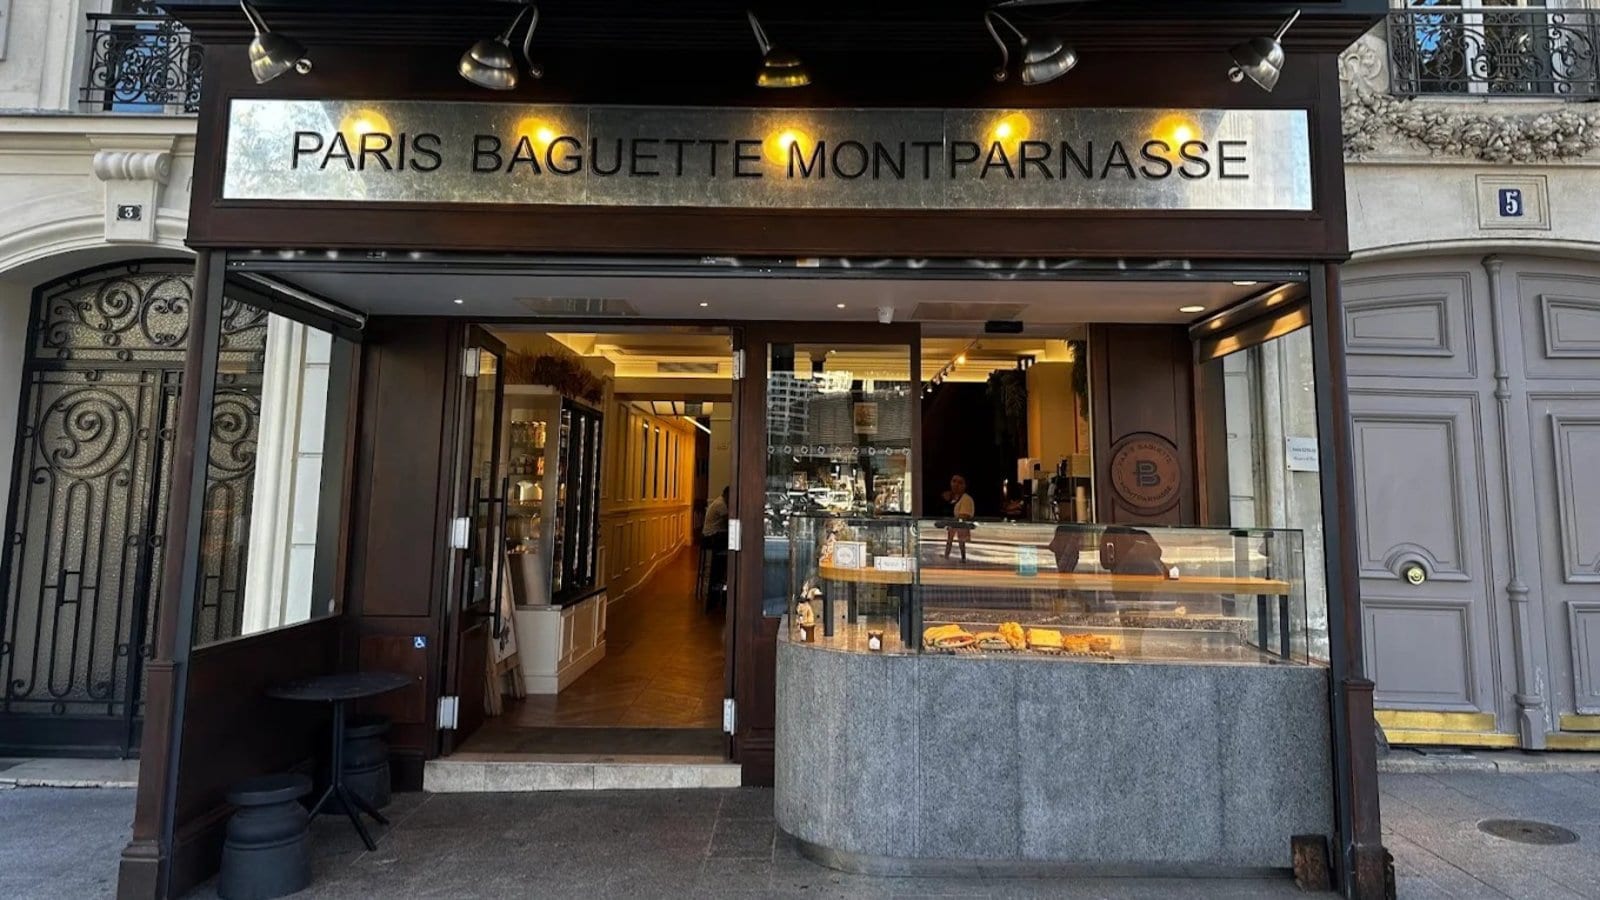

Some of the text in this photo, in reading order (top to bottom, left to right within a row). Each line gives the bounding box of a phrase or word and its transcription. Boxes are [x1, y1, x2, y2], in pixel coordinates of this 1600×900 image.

[291, 131, 1250, 181] PARIS BAGUETTE MONTPARNASSE
[125, 207, 133, 218] 3
[1505, 191, 1518, 214] 5
